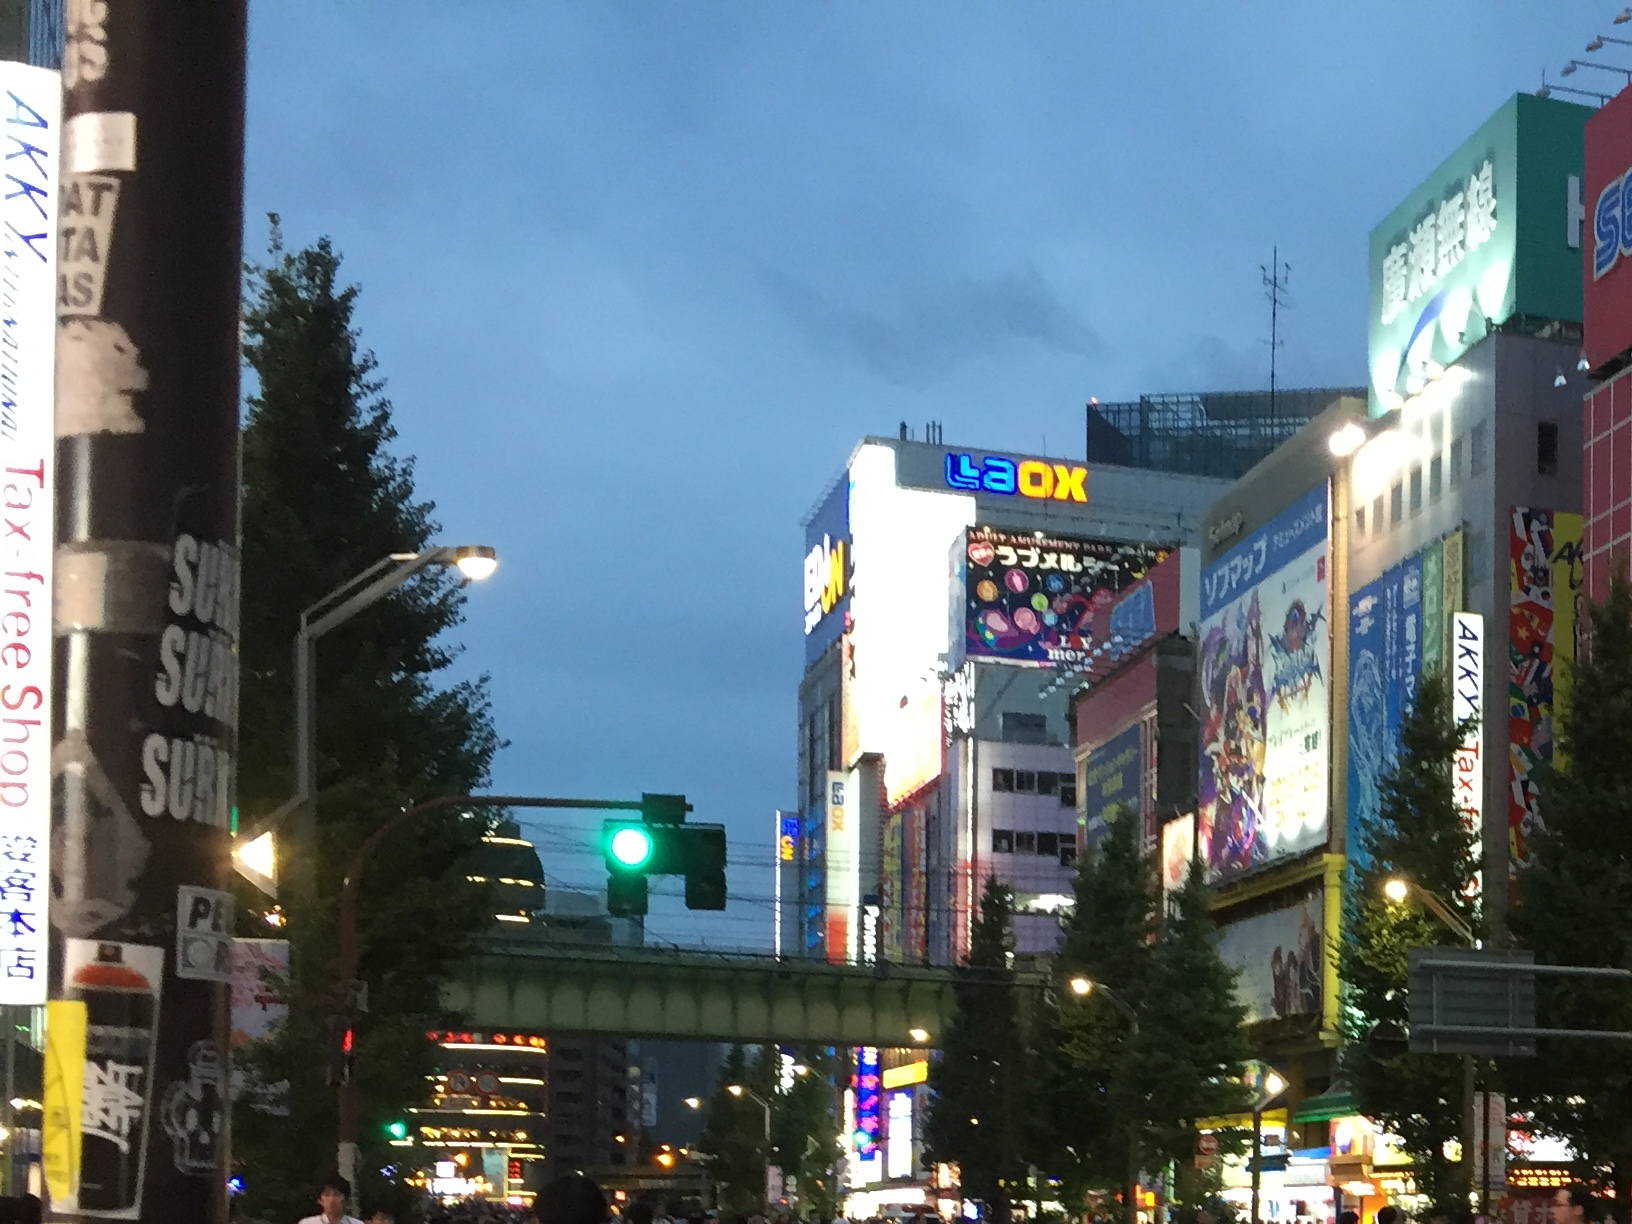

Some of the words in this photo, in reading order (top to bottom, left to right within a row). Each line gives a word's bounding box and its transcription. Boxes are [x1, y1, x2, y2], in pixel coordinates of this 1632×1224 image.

[4, 89, 48, 264] AKKY
[1, 458, 45, 670] Tax-free
[1204, 532, 1268, 608] ソフマップ
[1458, 618, 1480, 714] AKKY
[0, 683, 43, 810] Shop
[1458, 741, 1480, 853] Tax-fr
